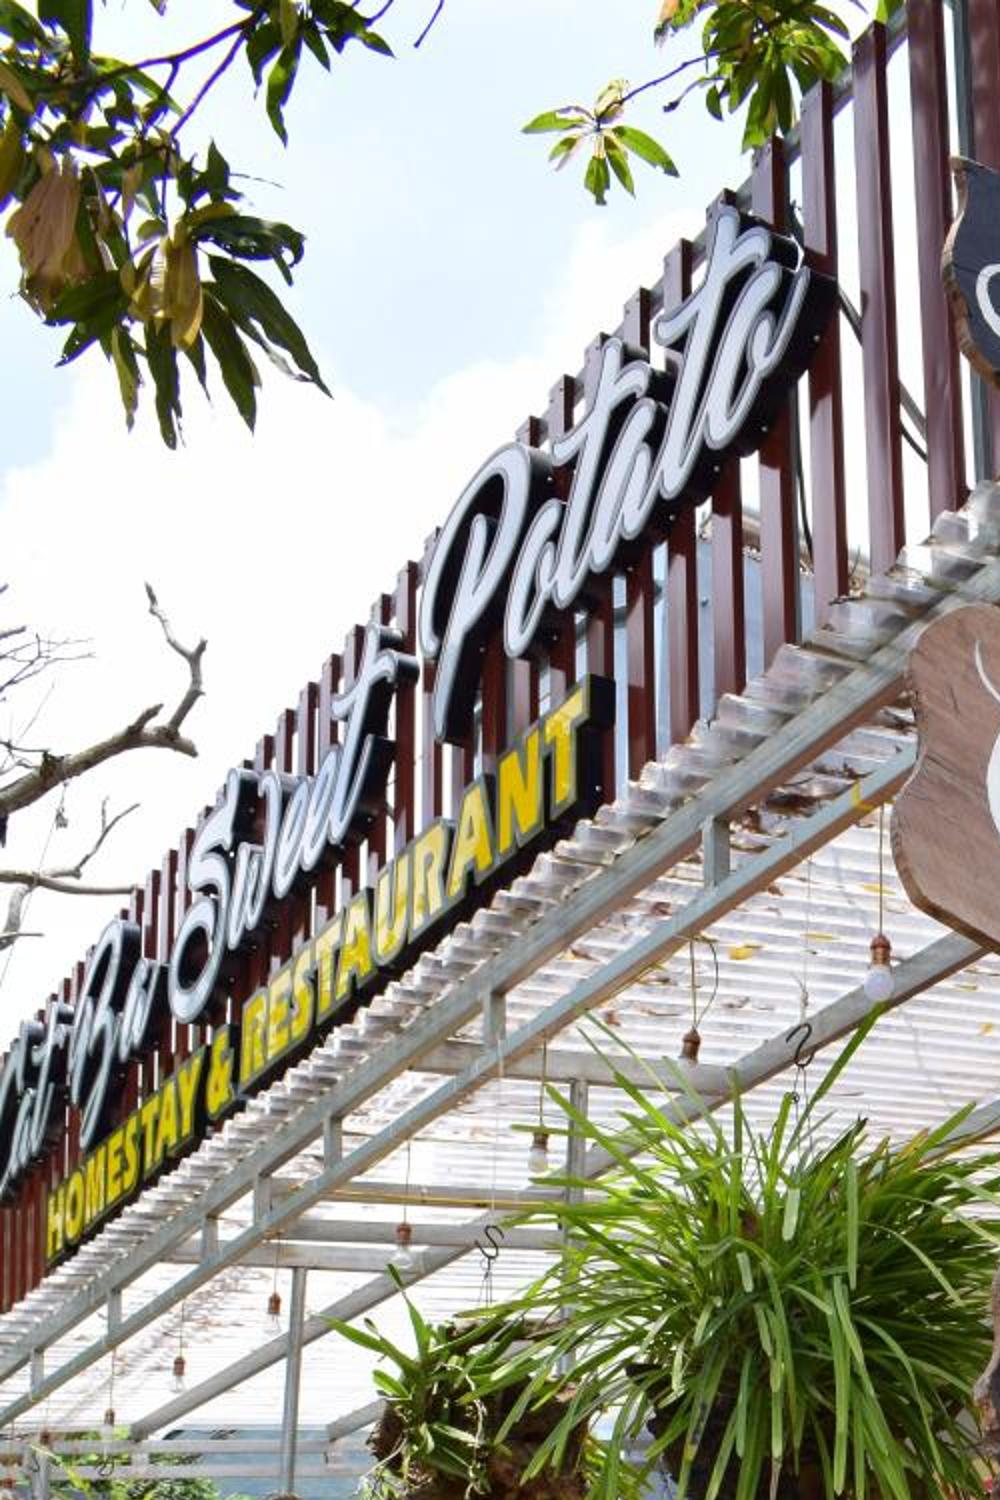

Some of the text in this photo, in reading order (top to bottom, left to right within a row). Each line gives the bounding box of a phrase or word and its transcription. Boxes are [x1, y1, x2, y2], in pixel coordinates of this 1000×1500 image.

[168, 623, 402, 1024] Sweet
[419, 204, 812, 744] Potato
[47, 690, 590, 1261] HOMESTAY & RESTAURANT
